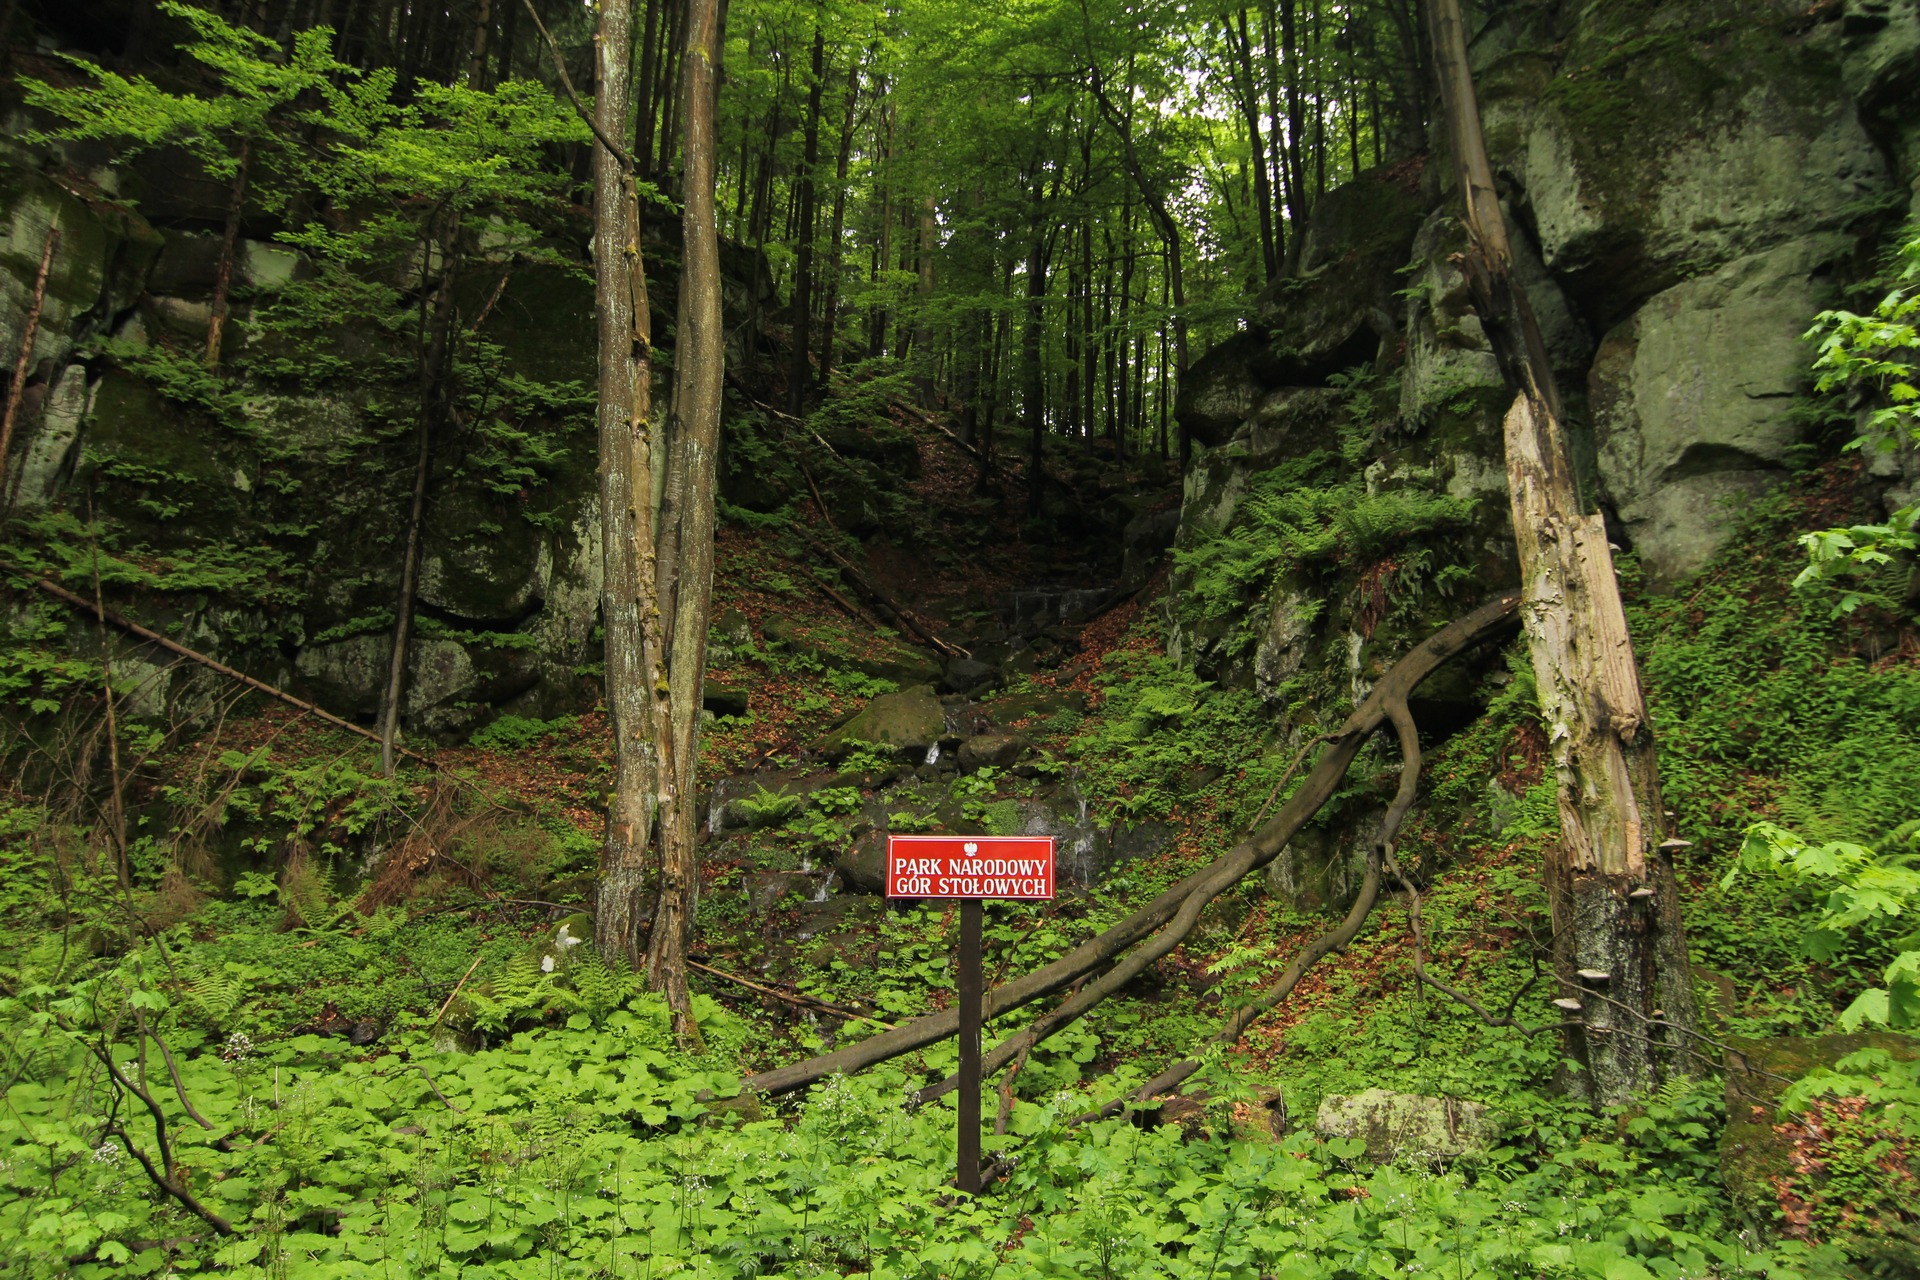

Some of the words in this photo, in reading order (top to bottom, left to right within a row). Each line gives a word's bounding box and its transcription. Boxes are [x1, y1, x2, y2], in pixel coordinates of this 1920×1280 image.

[895, 858, 942, 875] PARK
[949, 859, 1047, 876] NARODOWY
[896, 875, 931, 894] GÓR
[938, 878, 1046, 895] STOŁOWYCH
